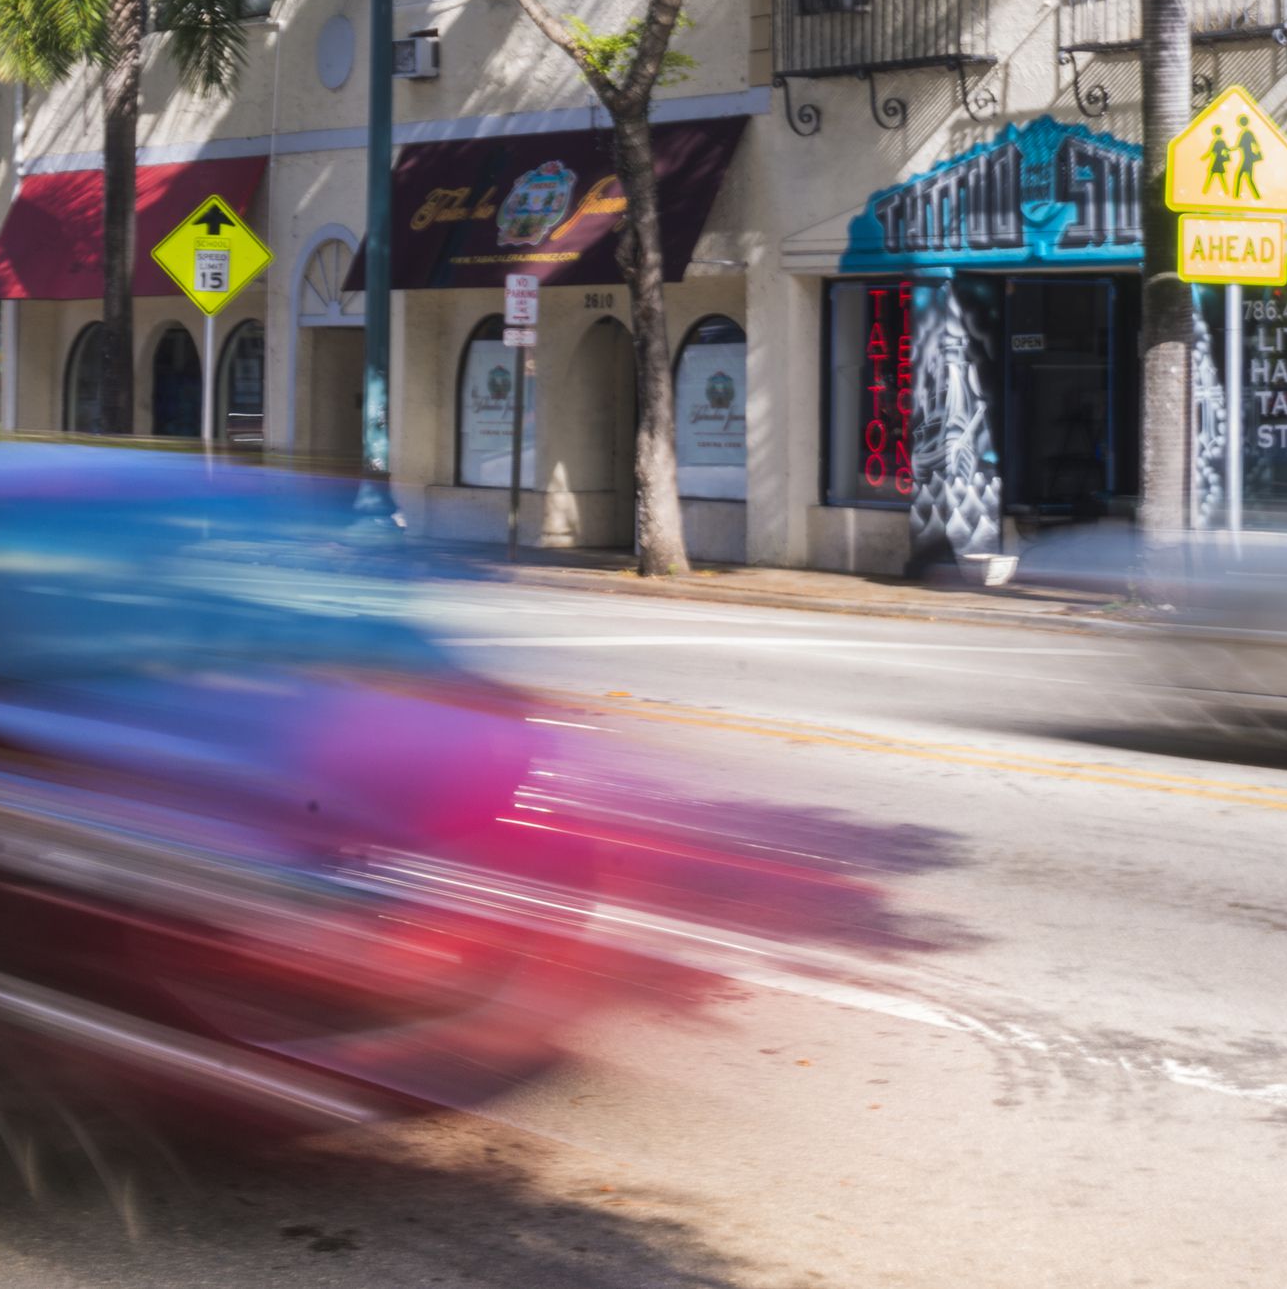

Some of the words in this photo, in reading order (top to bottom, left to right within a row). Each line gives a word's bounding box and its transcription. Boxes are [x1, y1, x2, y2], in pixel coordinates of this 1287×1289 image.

[874, 141, 1023, 251] TATTOO
[196, 239, 228, 249] SCHOOL
[1190, 234, 1275, 264] AHEAD
[197, 253, 228, 261] SPEED
[199, 262, 224, 270] LIMIT
[200, 271, 224, 289] 15
[584, 293, 613, 308] 2610
[866, 289, 889, 488] TATTOO
[895, 281, 913, 495] PIERCING
